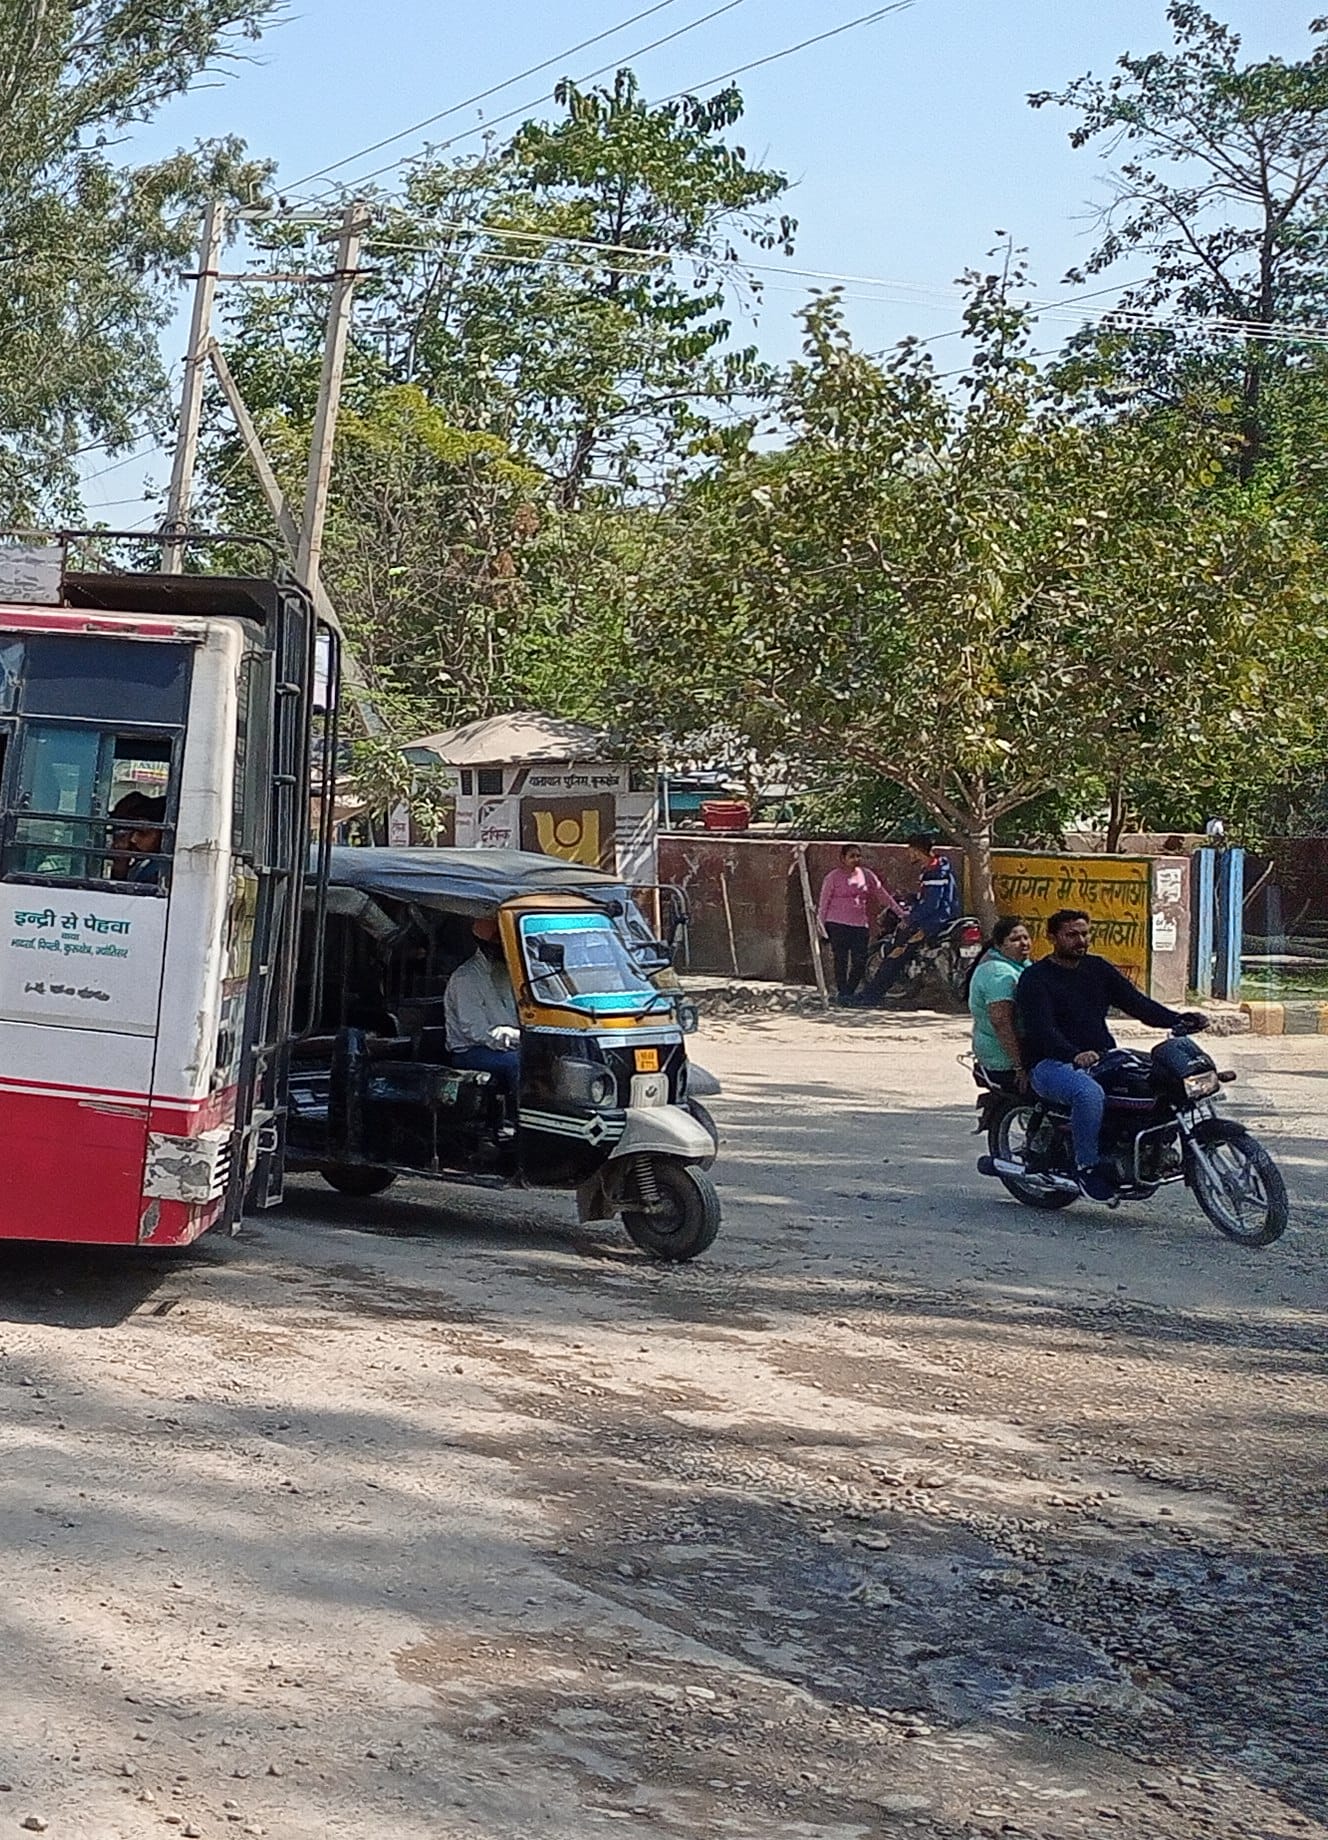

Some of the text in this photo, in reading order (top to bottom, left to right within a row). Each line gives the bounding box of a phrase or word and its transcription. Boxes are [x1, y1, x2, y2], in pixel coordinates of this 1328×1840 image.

[1058, 865, 1077, 899] में
[14, 908, 131, 935] इन्द्री से पेहवा
